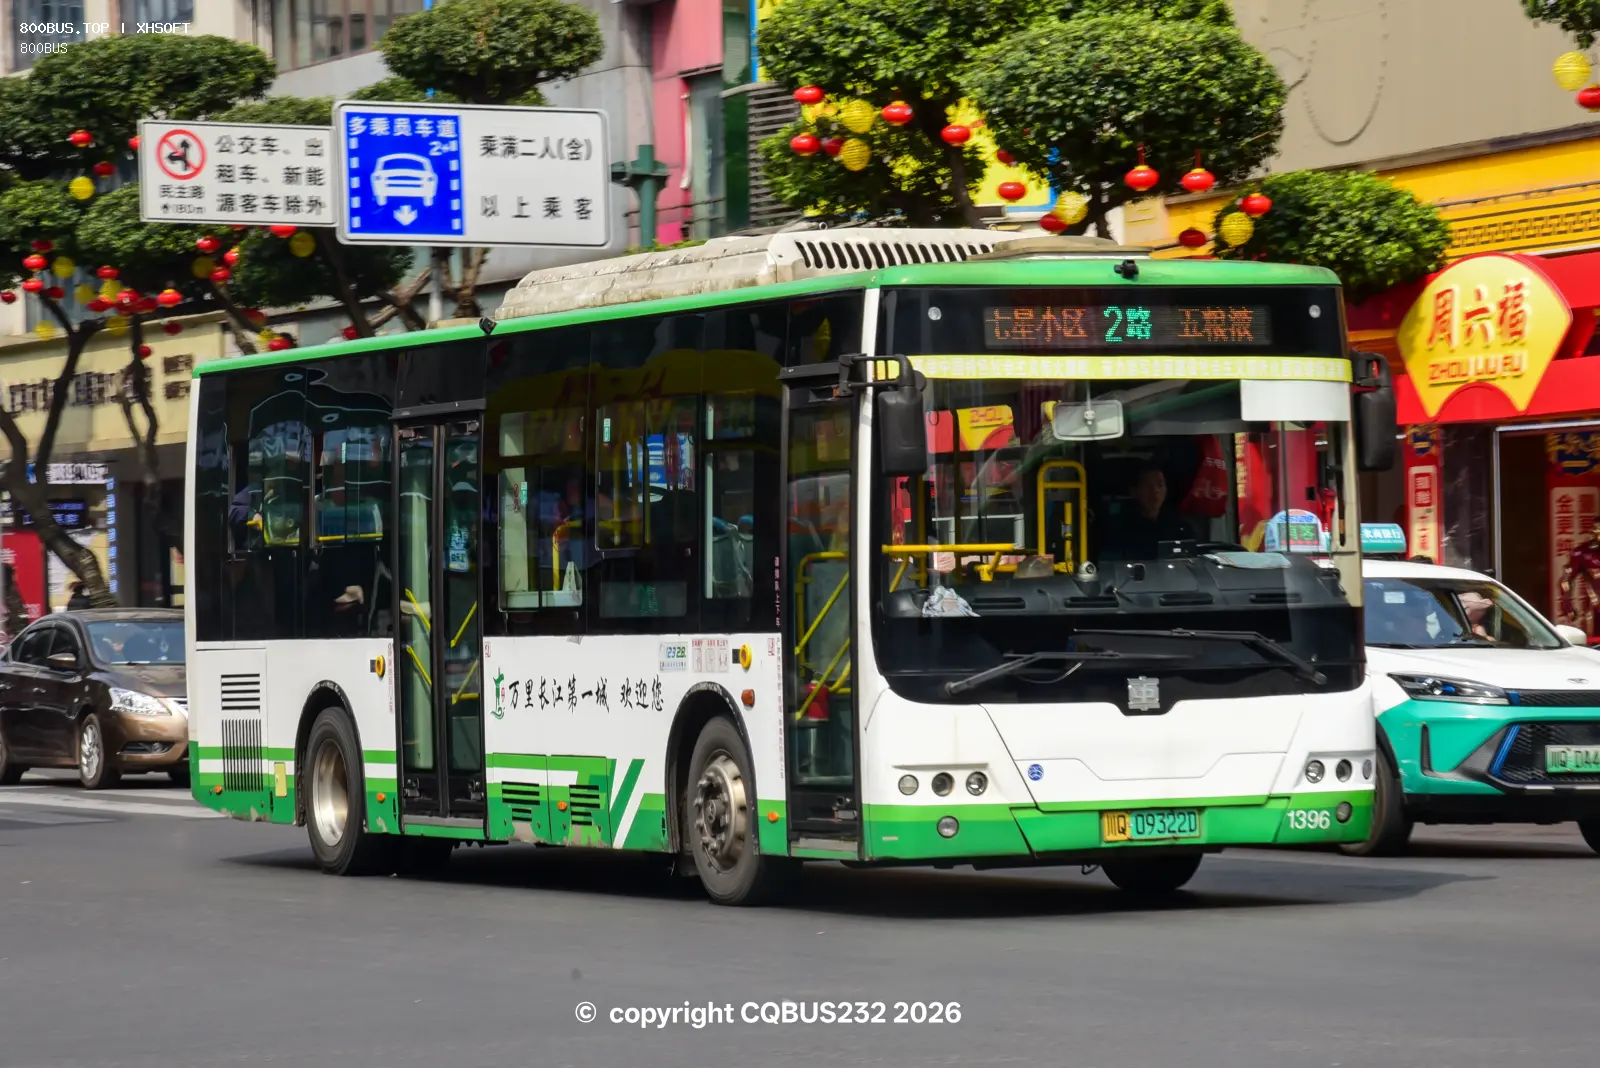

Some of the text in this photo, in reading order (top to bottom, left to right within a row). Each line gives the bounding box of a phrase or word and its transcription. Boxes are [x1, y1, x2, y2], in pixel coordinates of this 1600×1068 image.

[349, 116, 459, 139] 多乘员车道
[215, 134, 325, 158] 公交车、出
[216, 192, 327, 216] 源客车除外
[480, 194, 593, 221] 以上乘客
[986, 306, 1089, 342] 七星小区
[1103, 306, 1153, 342] 2路
[1427, 281, 1526, 348] 周六福
[508, 674, 610, 714] 万里长江第一城
[620, 674, 665, 712] 欢迎您
[1287, 809, 1331, 830] 1396
